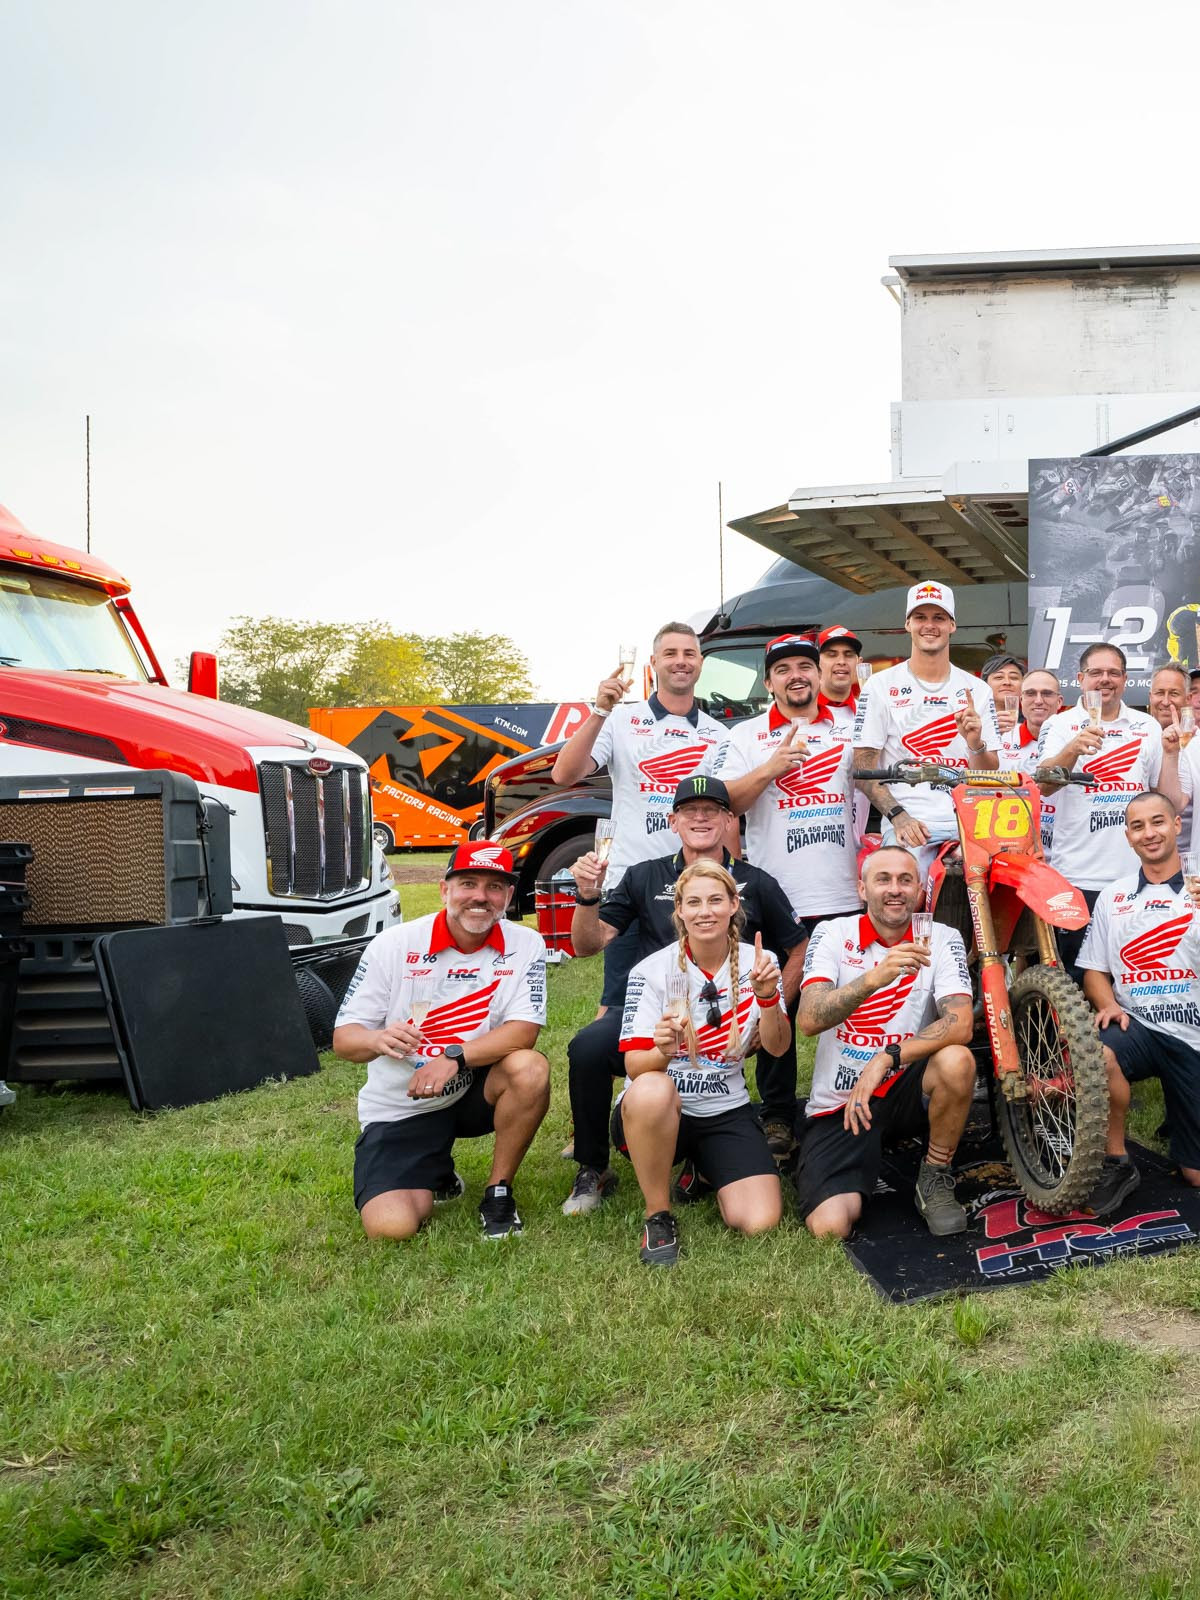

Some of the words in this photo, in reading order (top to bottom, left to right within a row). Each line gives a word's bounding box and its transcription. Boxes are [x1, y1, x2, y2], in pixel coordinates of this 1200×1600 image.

[901, 687, 912, 695] 96
[494, 716, 528, 738] KTM.COM
[642, 718, 654, 726] 96
[665, 728, 689, 738] HRC
[1084, 782, 1144, 793] HONDA
[778, 793, 846, 810] HONDA
[427, 806, 462, 827] RACING
[789, 807, 844, 820] PROGRESSIVE
[973, 798, 1032, 840] 18
[1090, 815, 1125, 833] CHAMP
[787, 828, 804, 836] 2025
[787, 831, 845, 854] CHAMPIONS
[469, 861, 504, 870] HONDA
[1127, 893, 1138, 901] 96
[1144, 900, 1173, 910] HRC
[406, 953, 420, 964] 18
[422, 954, 437, 964] 96
[447, 968, 481, 978] HRC
[1121, 969, 1198, 985] HONDA
[1130, 983, 1191, 997] PROGRESSIVE
[1150, 1003, 1165, 1011] 450
[984, 992, 1002, 1060] DUNLOP
[838, 1064, 857, 1076] 2025
[686, 1072, 703, 1081] 450
[705, 1073, 721, 1082] AMA
[976, 1209, 1190, 1273] HRC
